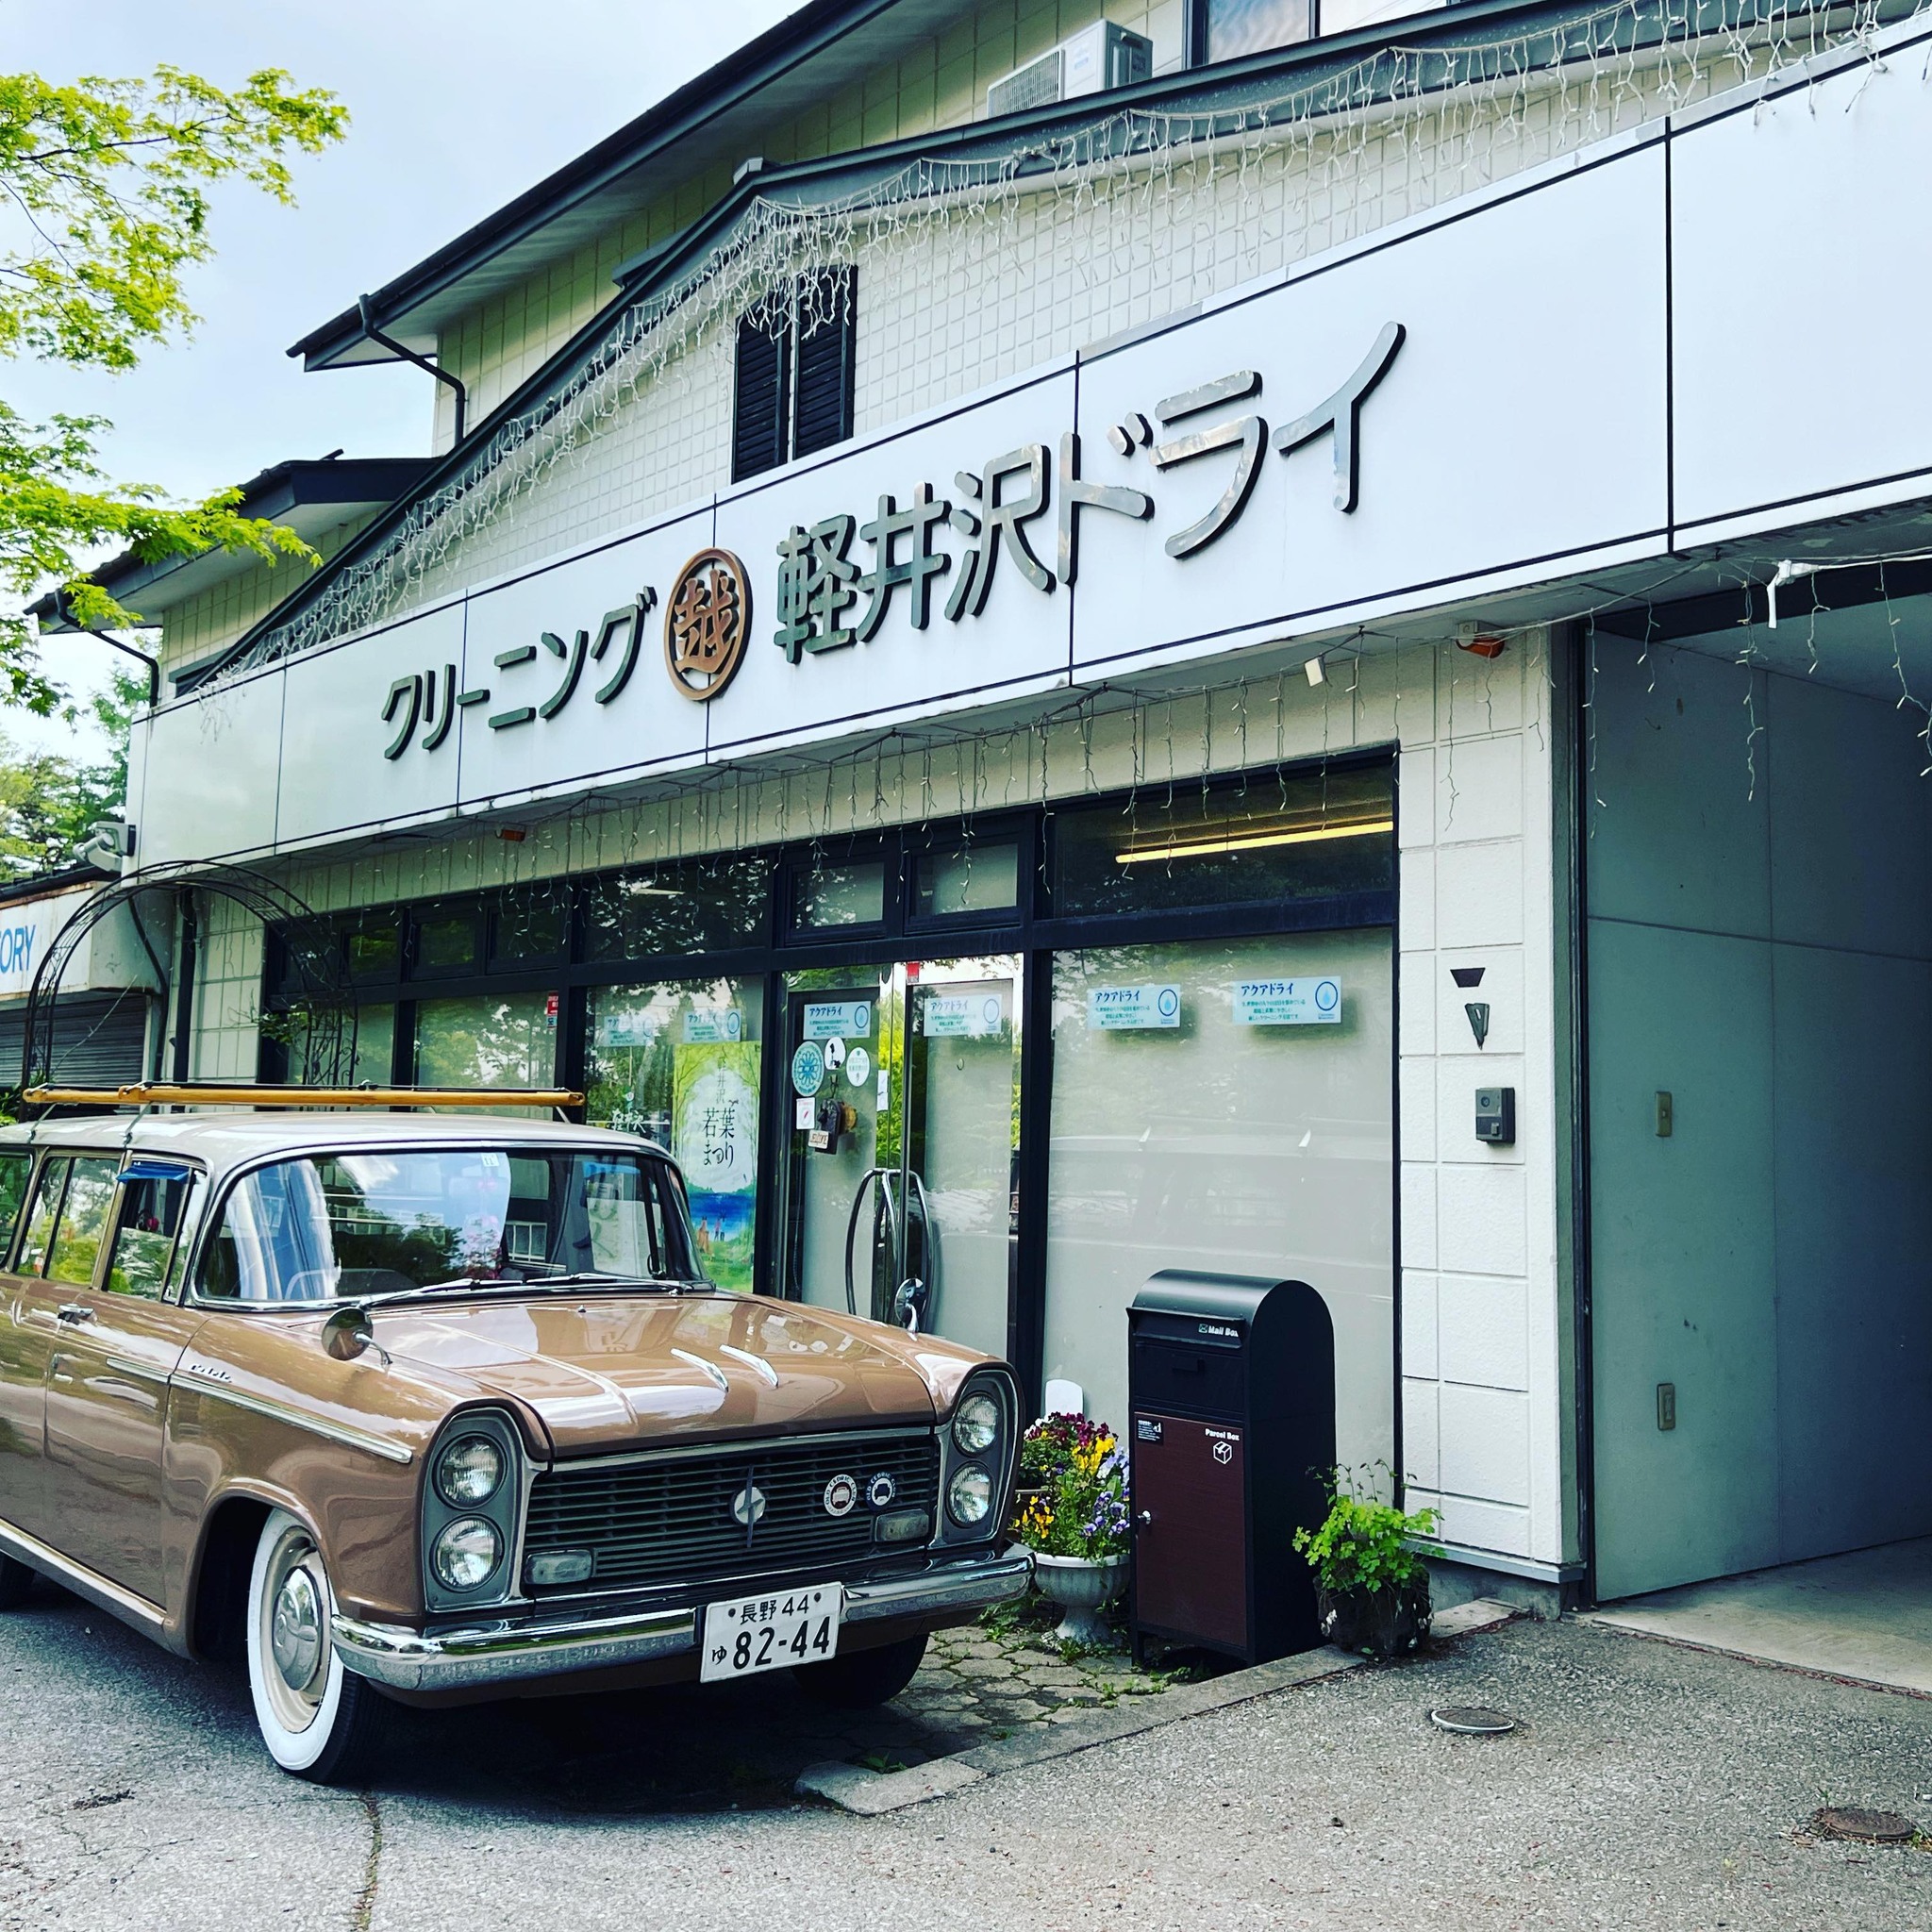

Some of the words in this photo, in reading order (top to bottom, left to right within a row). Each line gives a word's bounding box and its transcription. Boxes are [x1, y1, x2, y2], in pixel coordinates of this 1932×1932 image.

[381, 586, 658, 760] クリーニング
[774, 321, 1406, 665] 軽井沢ドライ
[0, 924, 36, 973] ORY
[1095, 990, 1140, 1003] アクアドライ
[1241, 982, 1293, 997] アクアドライ
[809, 1006, 842, 1017] アクアドライ
[703, 1107, 735, 1139] 若葉
[703, 1141, 734, 1169] まつり
[1208, 1325, 1224, 1335] Mail
[1224, 1327, 1239, 1338] Box
[1205, 1428, 1226, 1439] Parcel
[1226, 1432, 1240, 1441] Box
[741, 1600, 776, 1624] 長野
[782, 1593, 809, 1616] 44
[711, 1645, 727, 1665] ゆ
[733, 1616, 830, 1670] 82-44
